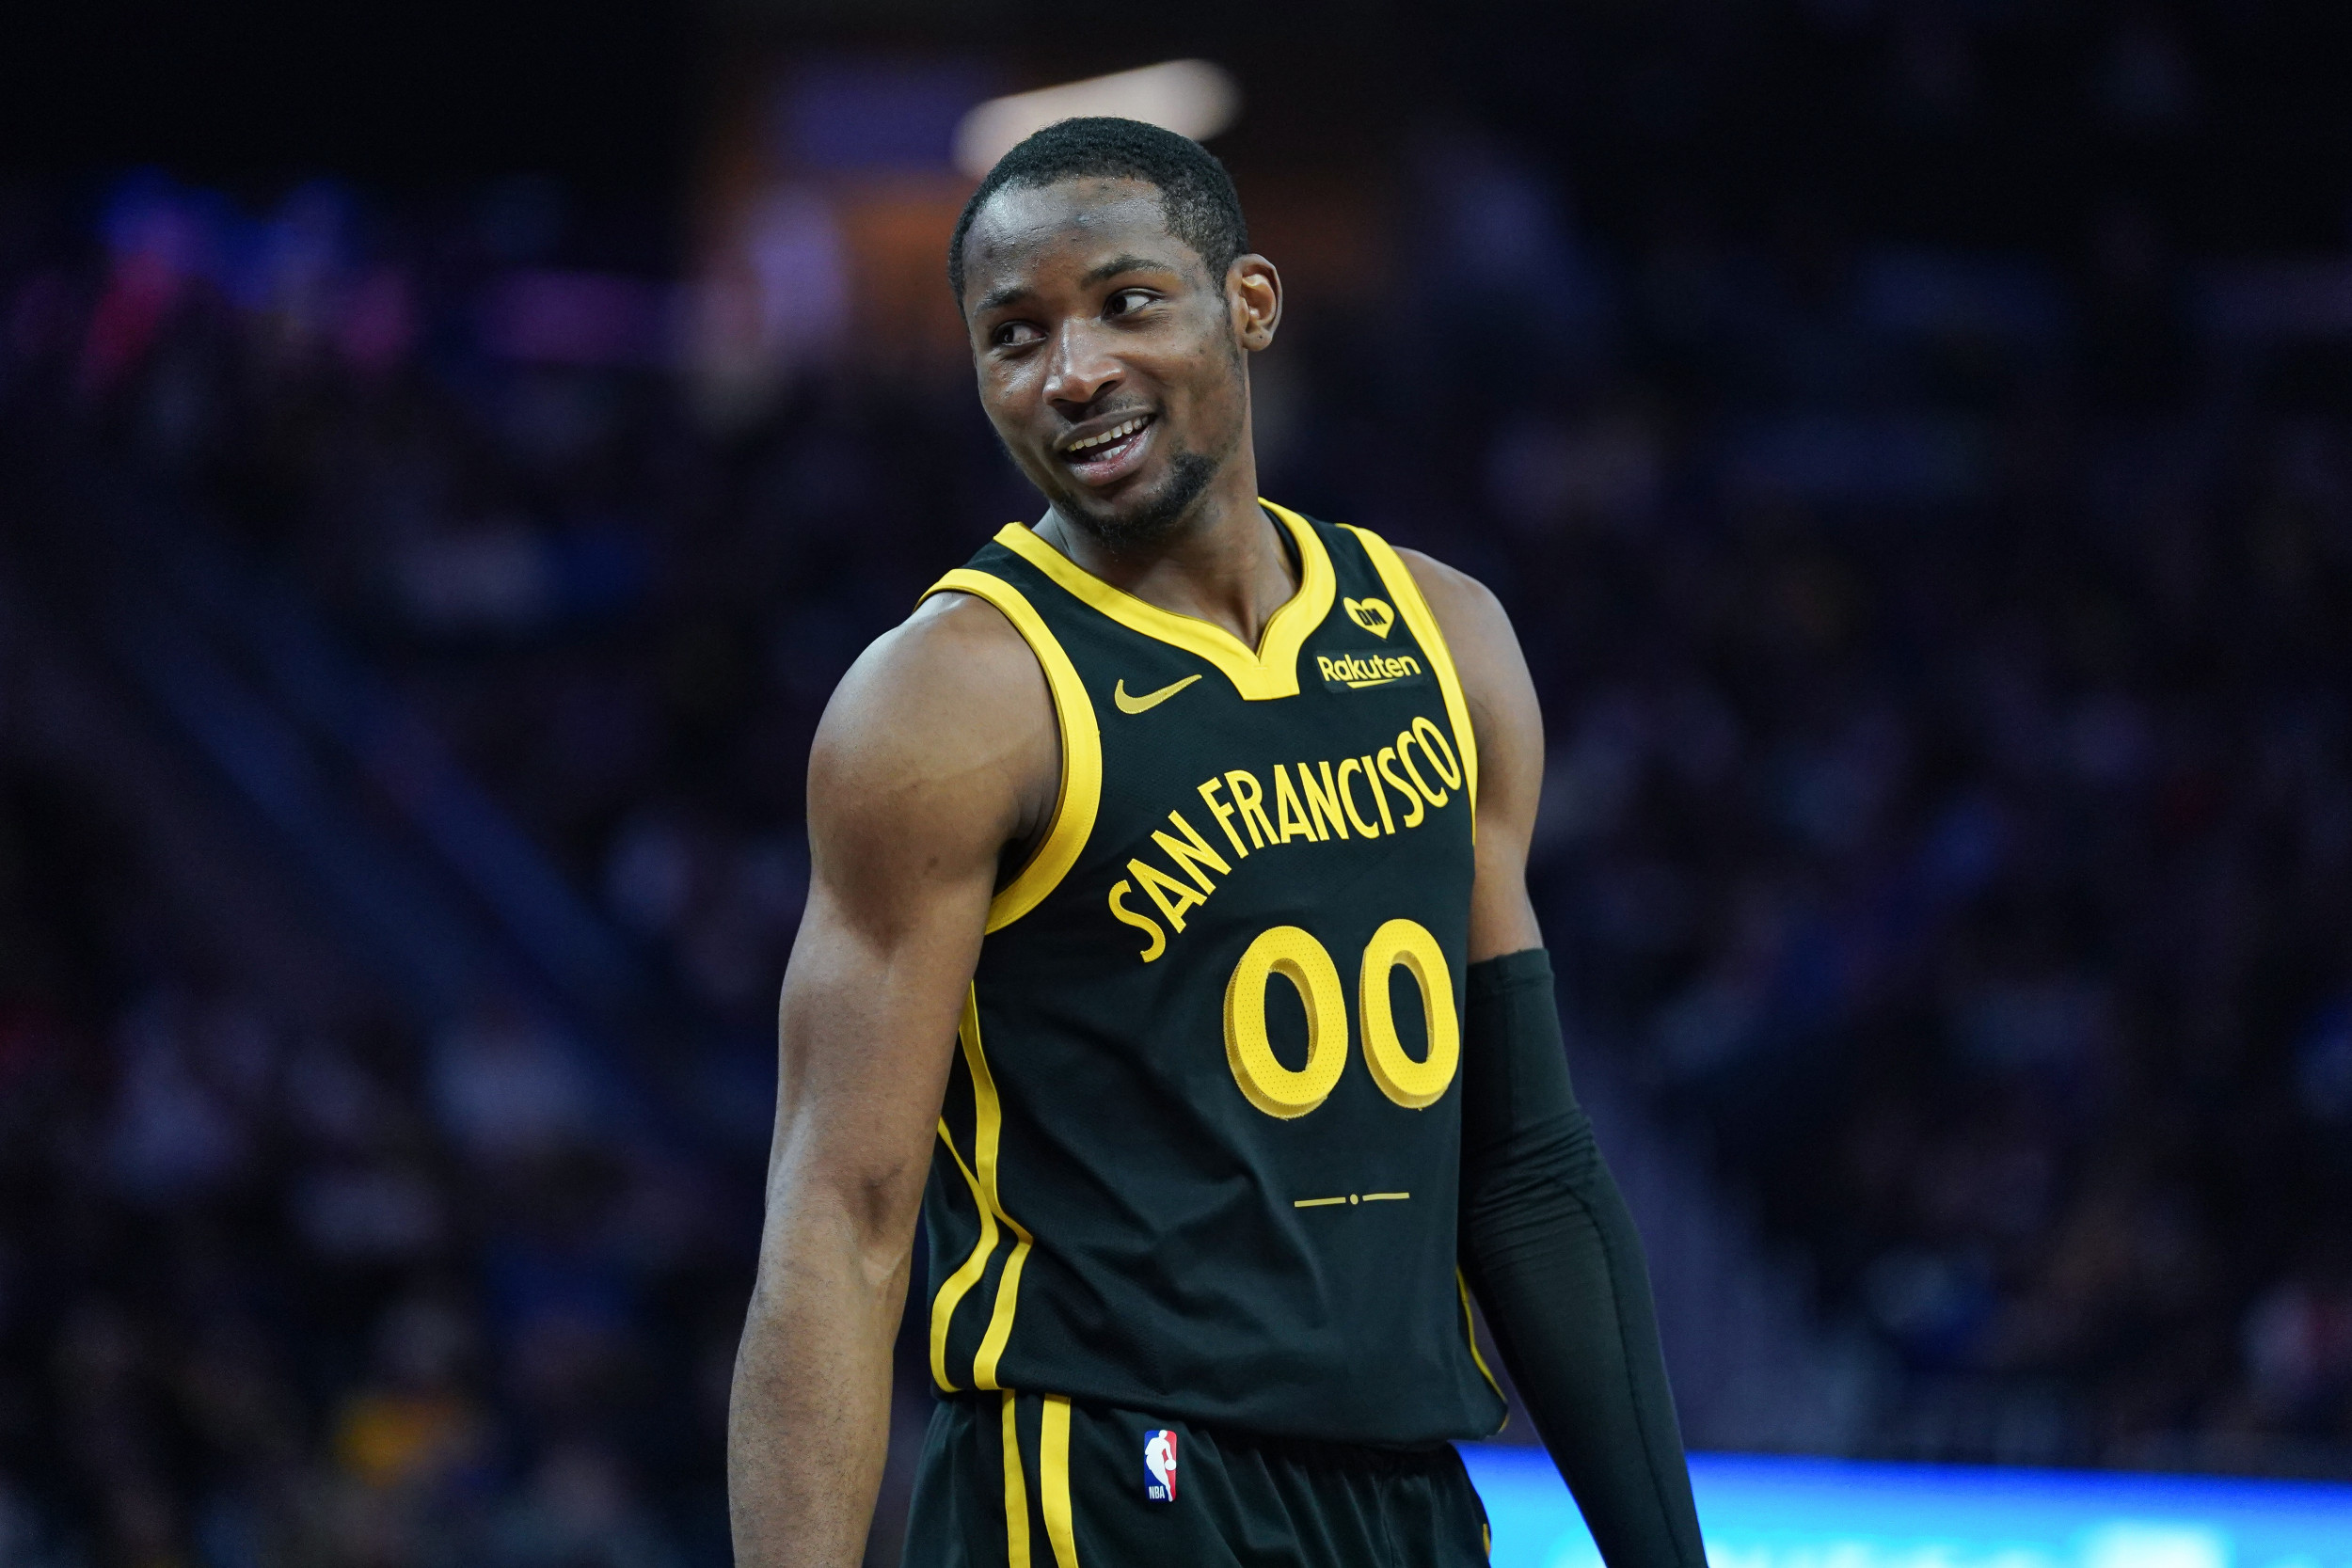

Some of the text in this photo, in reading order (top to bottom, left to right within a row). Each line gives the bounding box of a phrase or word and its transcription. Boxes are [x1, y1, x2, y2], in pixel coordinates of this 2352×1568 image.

[1355, 608, 1388, 626] DM
[1317, 654, 1422, 682] Rakuten
[1108, 716, 1461, 962] SAN FRANCISCO
[1223, 918, 1460, 1119] 00
[1149, 1486, 1166, 1499] NBA
